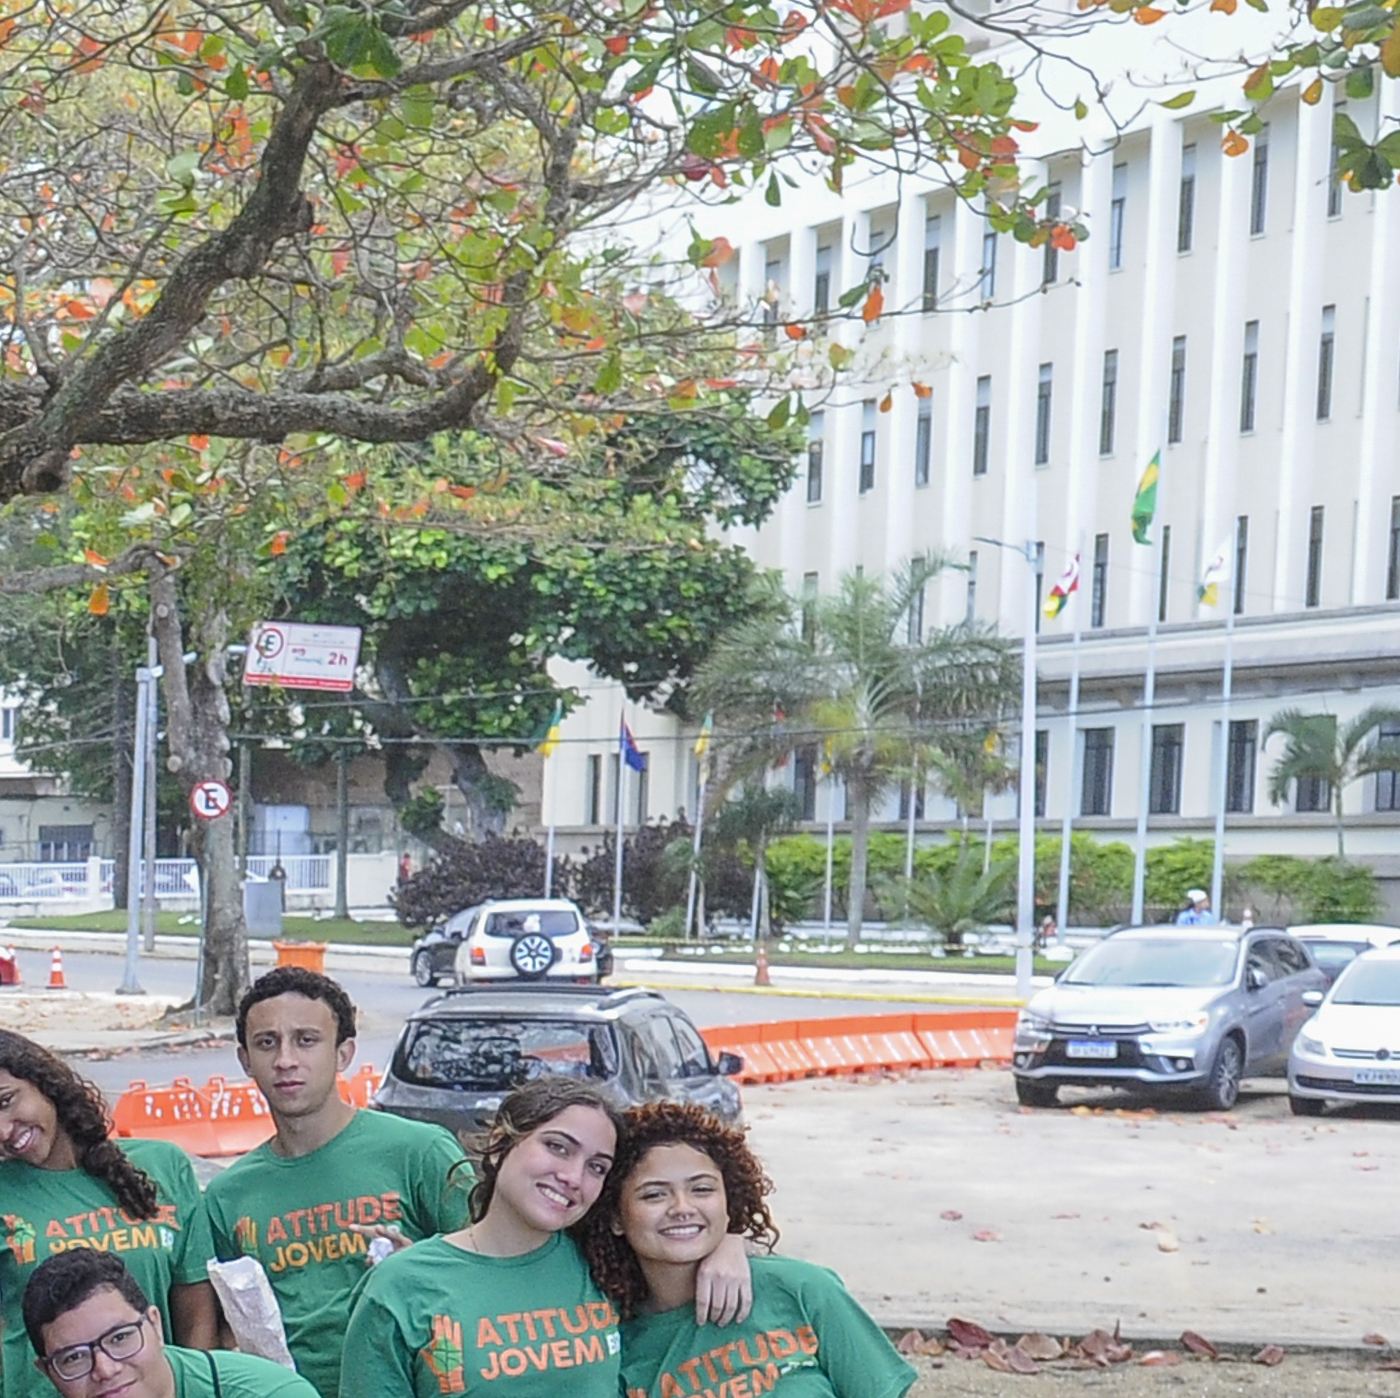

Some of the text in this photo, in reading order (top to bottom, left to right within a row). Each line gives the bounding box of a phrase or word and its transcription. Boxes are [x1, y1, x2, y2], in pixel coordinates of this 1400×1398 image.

[327, 652, 349, 666] 2h
[267, 1191, 402, 1245] ATITUDE
[269, 1231, 367, 1273] JOVEM
[476, 1302, 620, 1349] ATITUD
[480, 1334, 605, 1381] JOVEM
